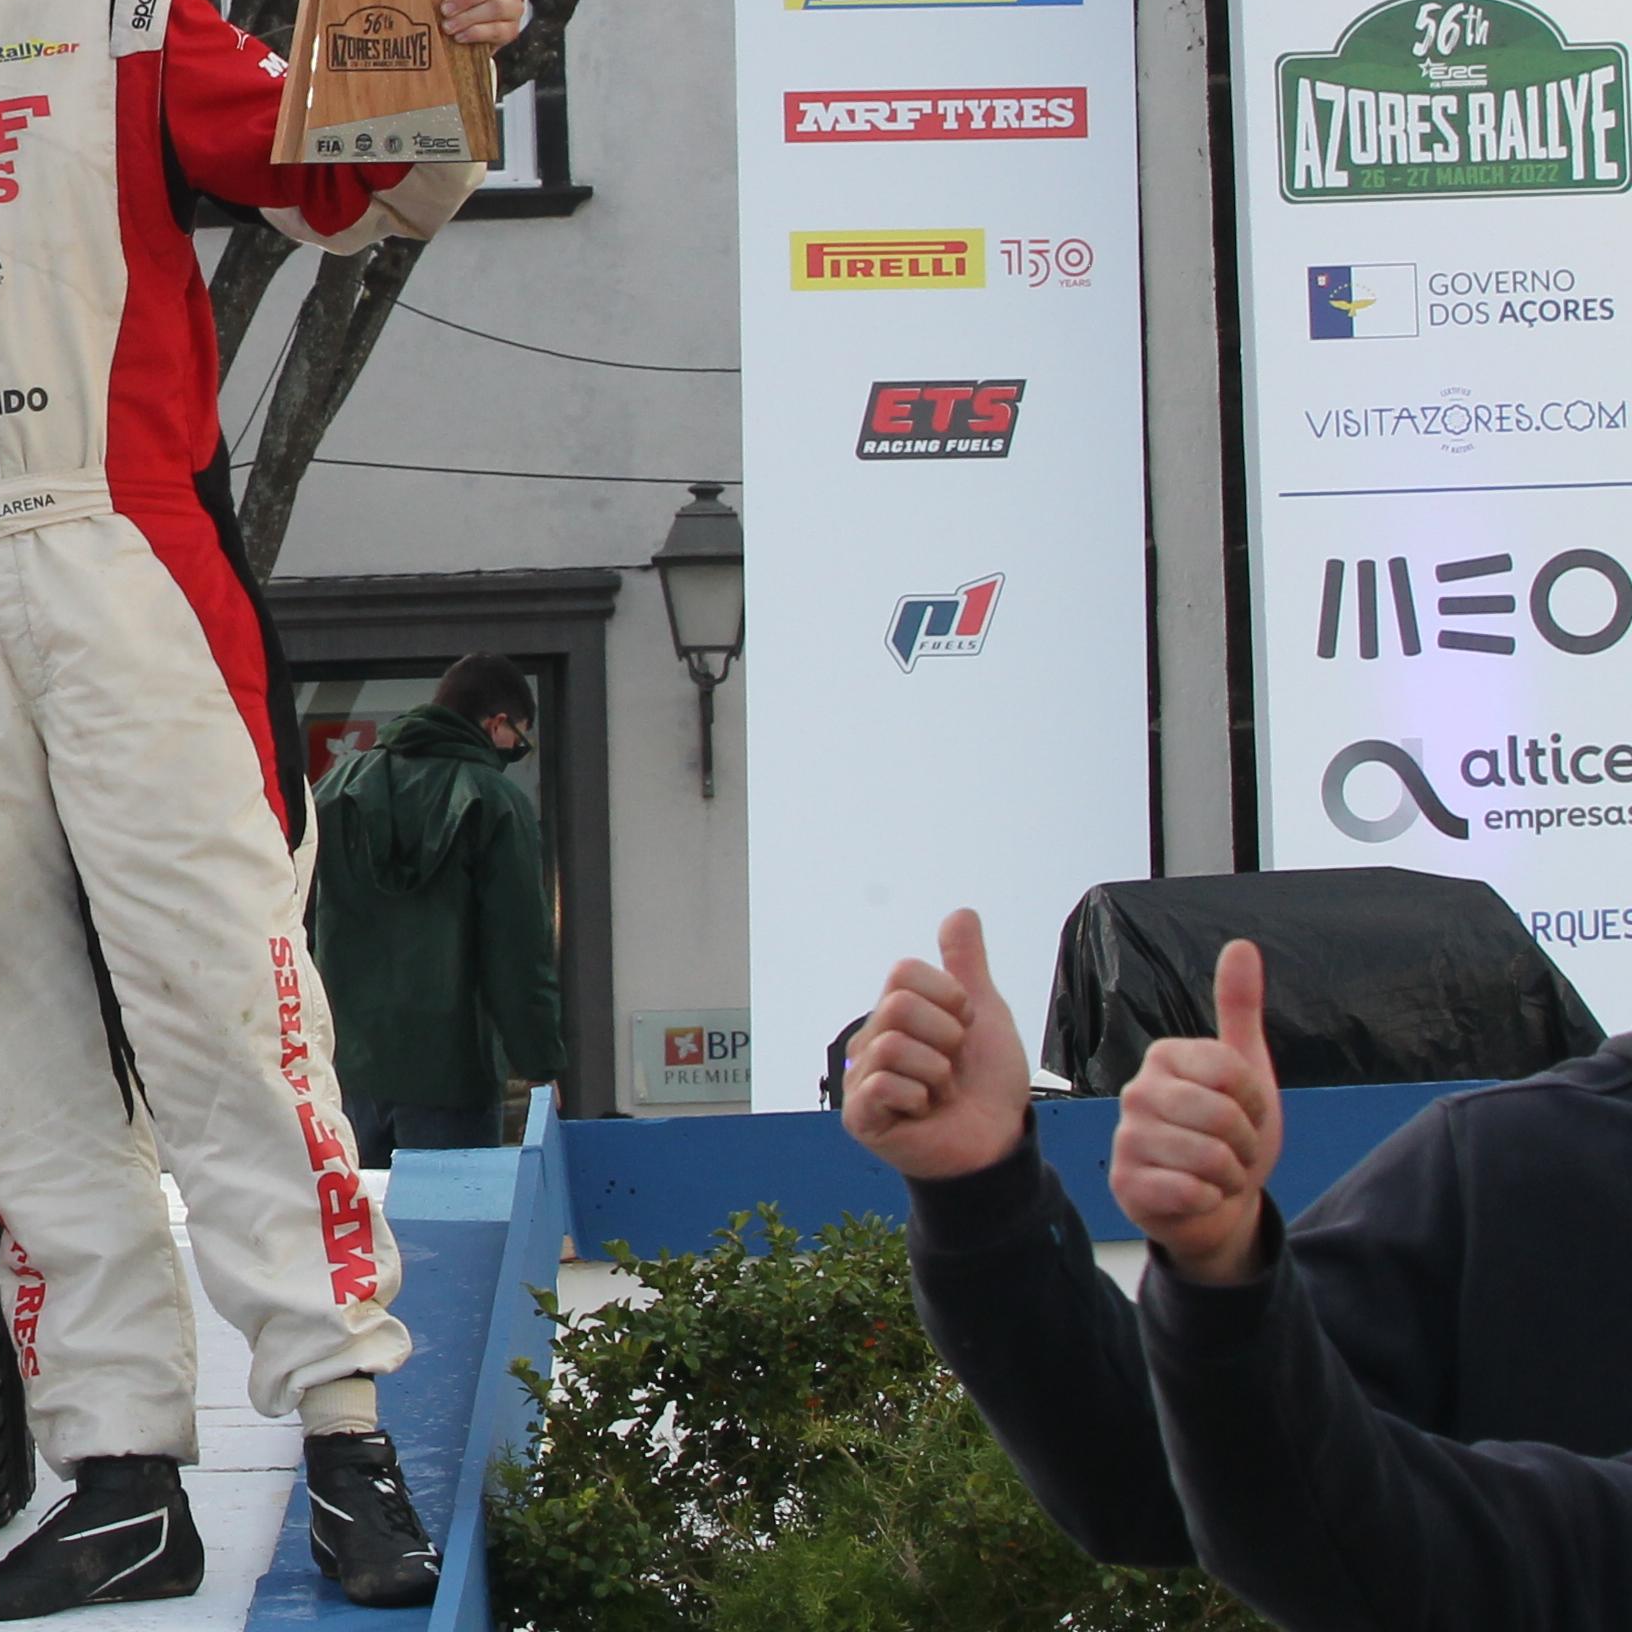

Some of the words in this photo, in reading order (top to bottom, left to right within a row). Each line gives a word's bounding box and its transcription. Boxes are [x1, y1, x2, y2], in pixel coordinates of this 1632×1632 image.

[1413, 3, 1489, 56] 56th
[796, 101, 932, 132] MRF
[938, 98, 1075, 130] TYRES
[1294, 77, 1458, 188] AZORES
[1468, 65, 1618, 180] RALLYE
[806, 241, 968, 279] PIRELLI
[1058, 279, 1092, 288] YEARS
[1429, 268, 1575, 296] GOVERNO
[1429, 300, 1490, 326] DOS
[1498, 298, 1614, 327] AÇORES
[871, 387, 1017, 433] ETS
[1305, 400, 1626, 438] VISITAZORES.COM
[863, 439, 940, 453] RACING
[946, 439, 1004, 452] FUELS
[919, 640, 977, 650] FUELS
[1461, 733, 1632, 787] altice
[1485, 806, 1632, 835] empresa
[267, 936, 312, 1097] TYRES
[295, 1101, 379, 1306] MRF
